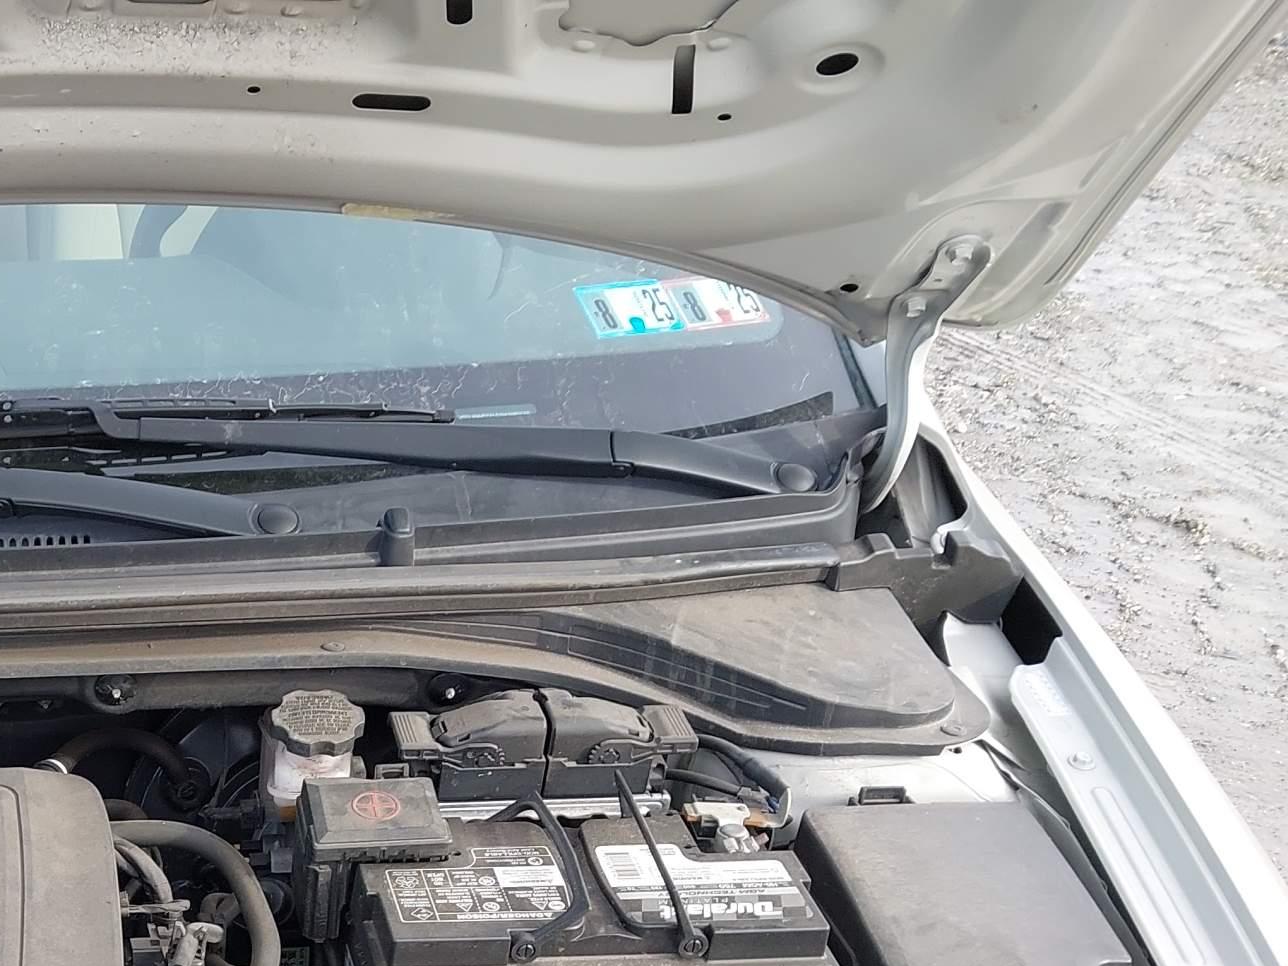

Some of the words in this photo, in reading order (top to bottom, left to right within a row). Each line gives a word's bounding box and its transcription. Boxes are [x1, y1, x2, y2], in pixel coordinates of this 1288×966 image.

[642, 288, 674, 322] 25
[657, 897, 729, 905] PLATINM
[658, 900, 784, 920] Duralat
